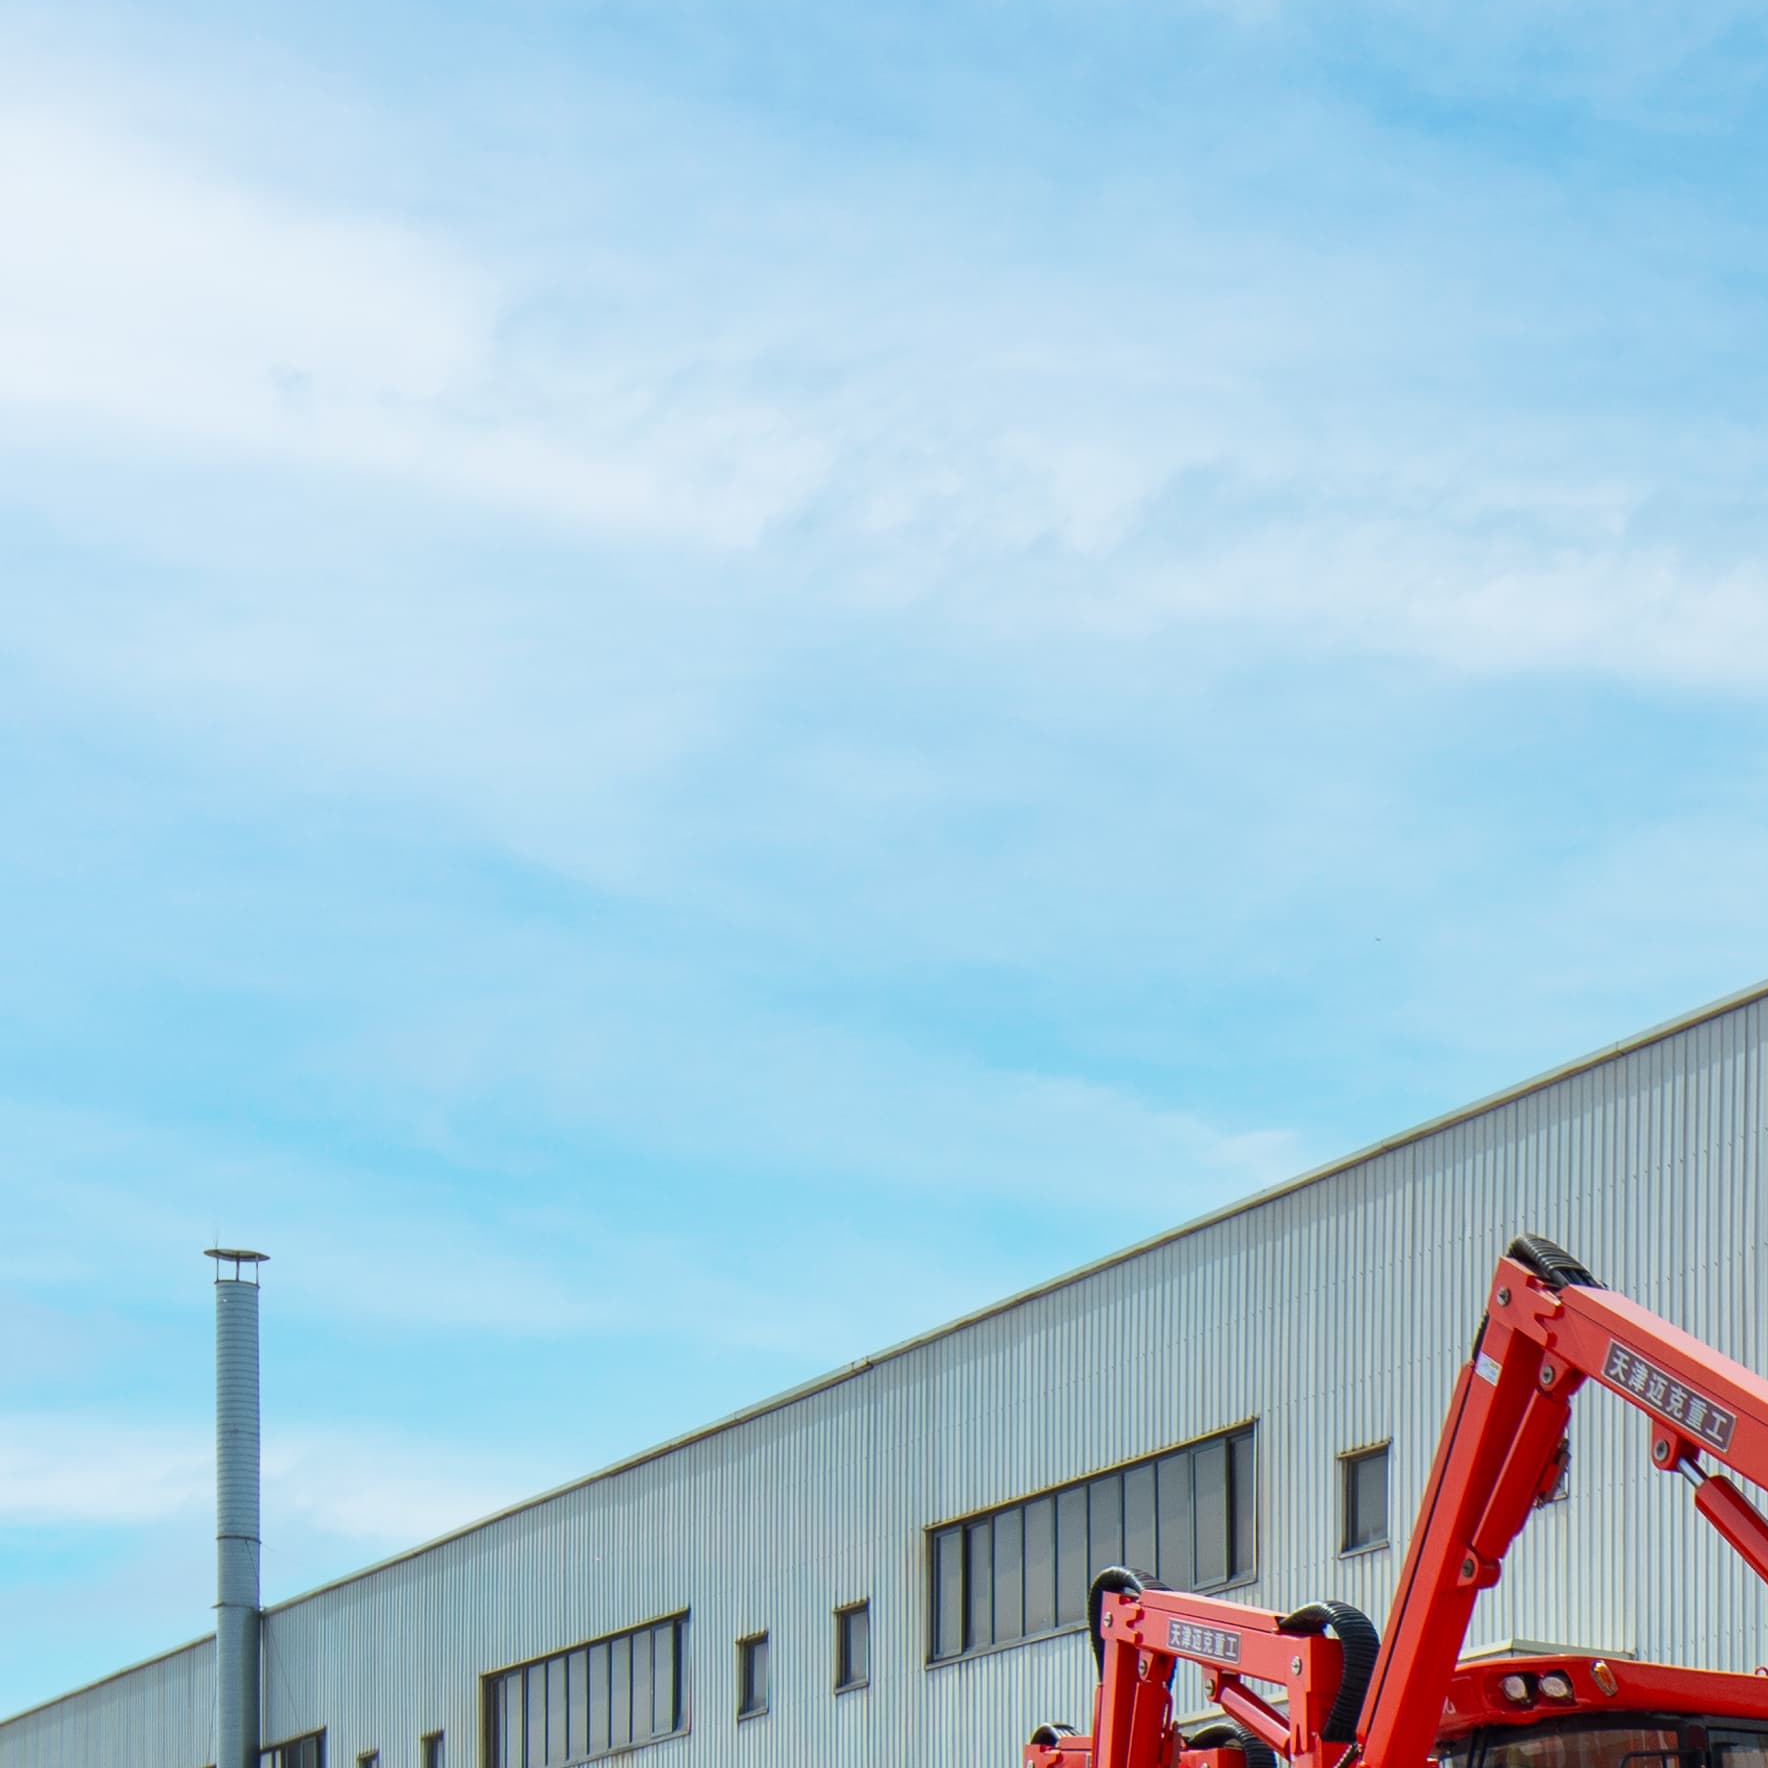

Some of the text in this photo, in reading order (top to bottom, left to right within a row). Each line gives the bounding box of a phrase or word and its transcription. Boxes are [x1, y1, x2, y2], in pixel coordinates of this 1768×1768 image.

[1609, 1349, 1728, 1442] 天津迈克重工
[1170, 1623, 1238, 1657] 天津迈克重工
